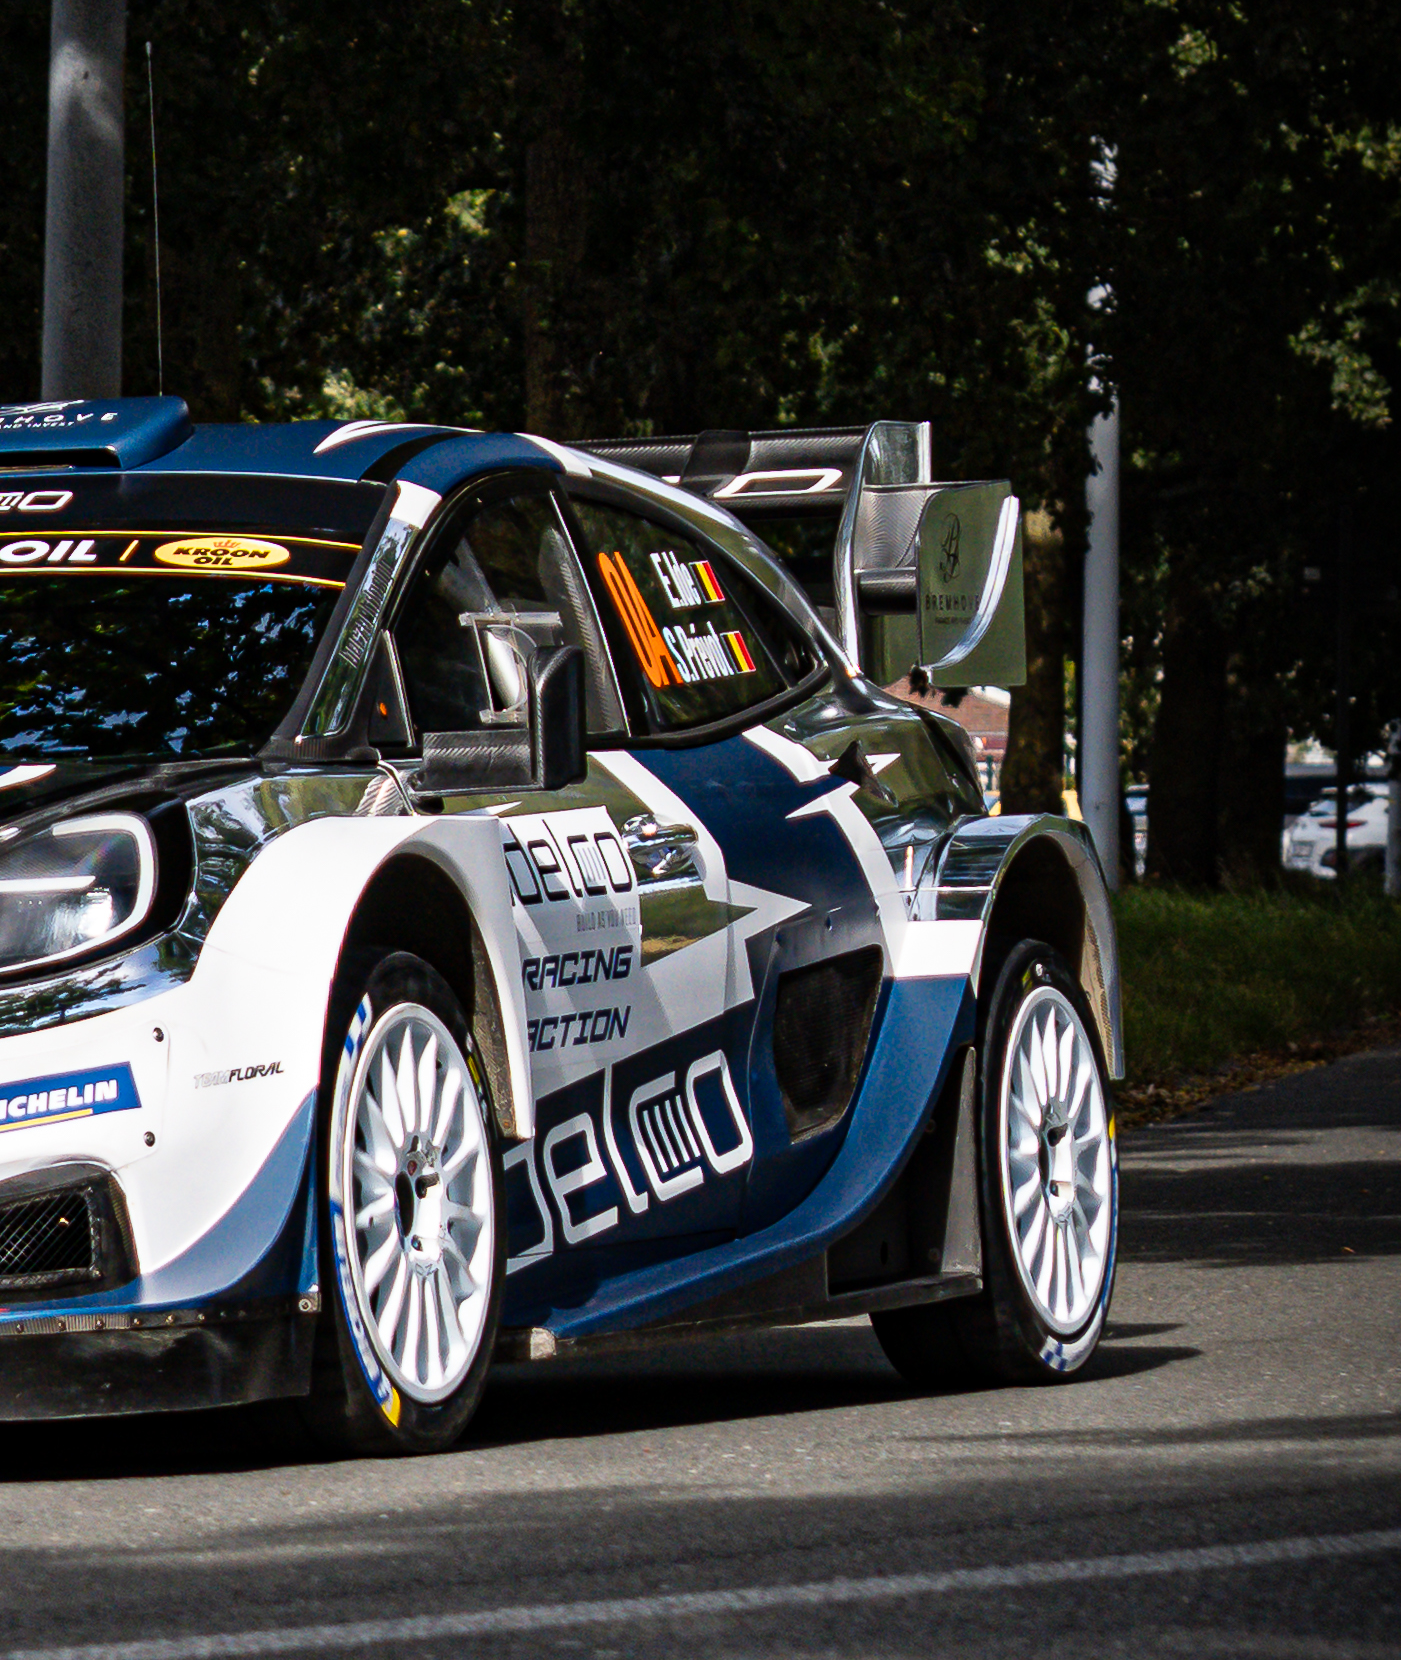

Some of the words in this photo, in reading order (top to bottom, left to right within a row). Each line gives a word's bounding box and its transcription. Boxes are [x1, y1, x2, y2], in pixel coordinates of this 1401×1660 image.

[172, 547, 271, 559] KROON
[193, 556, 234, 567] OIL
[502, 818, 632, 907] delco
[522, 944, 634, 991] RACING
[502, 1049, 753, 1275] delco
